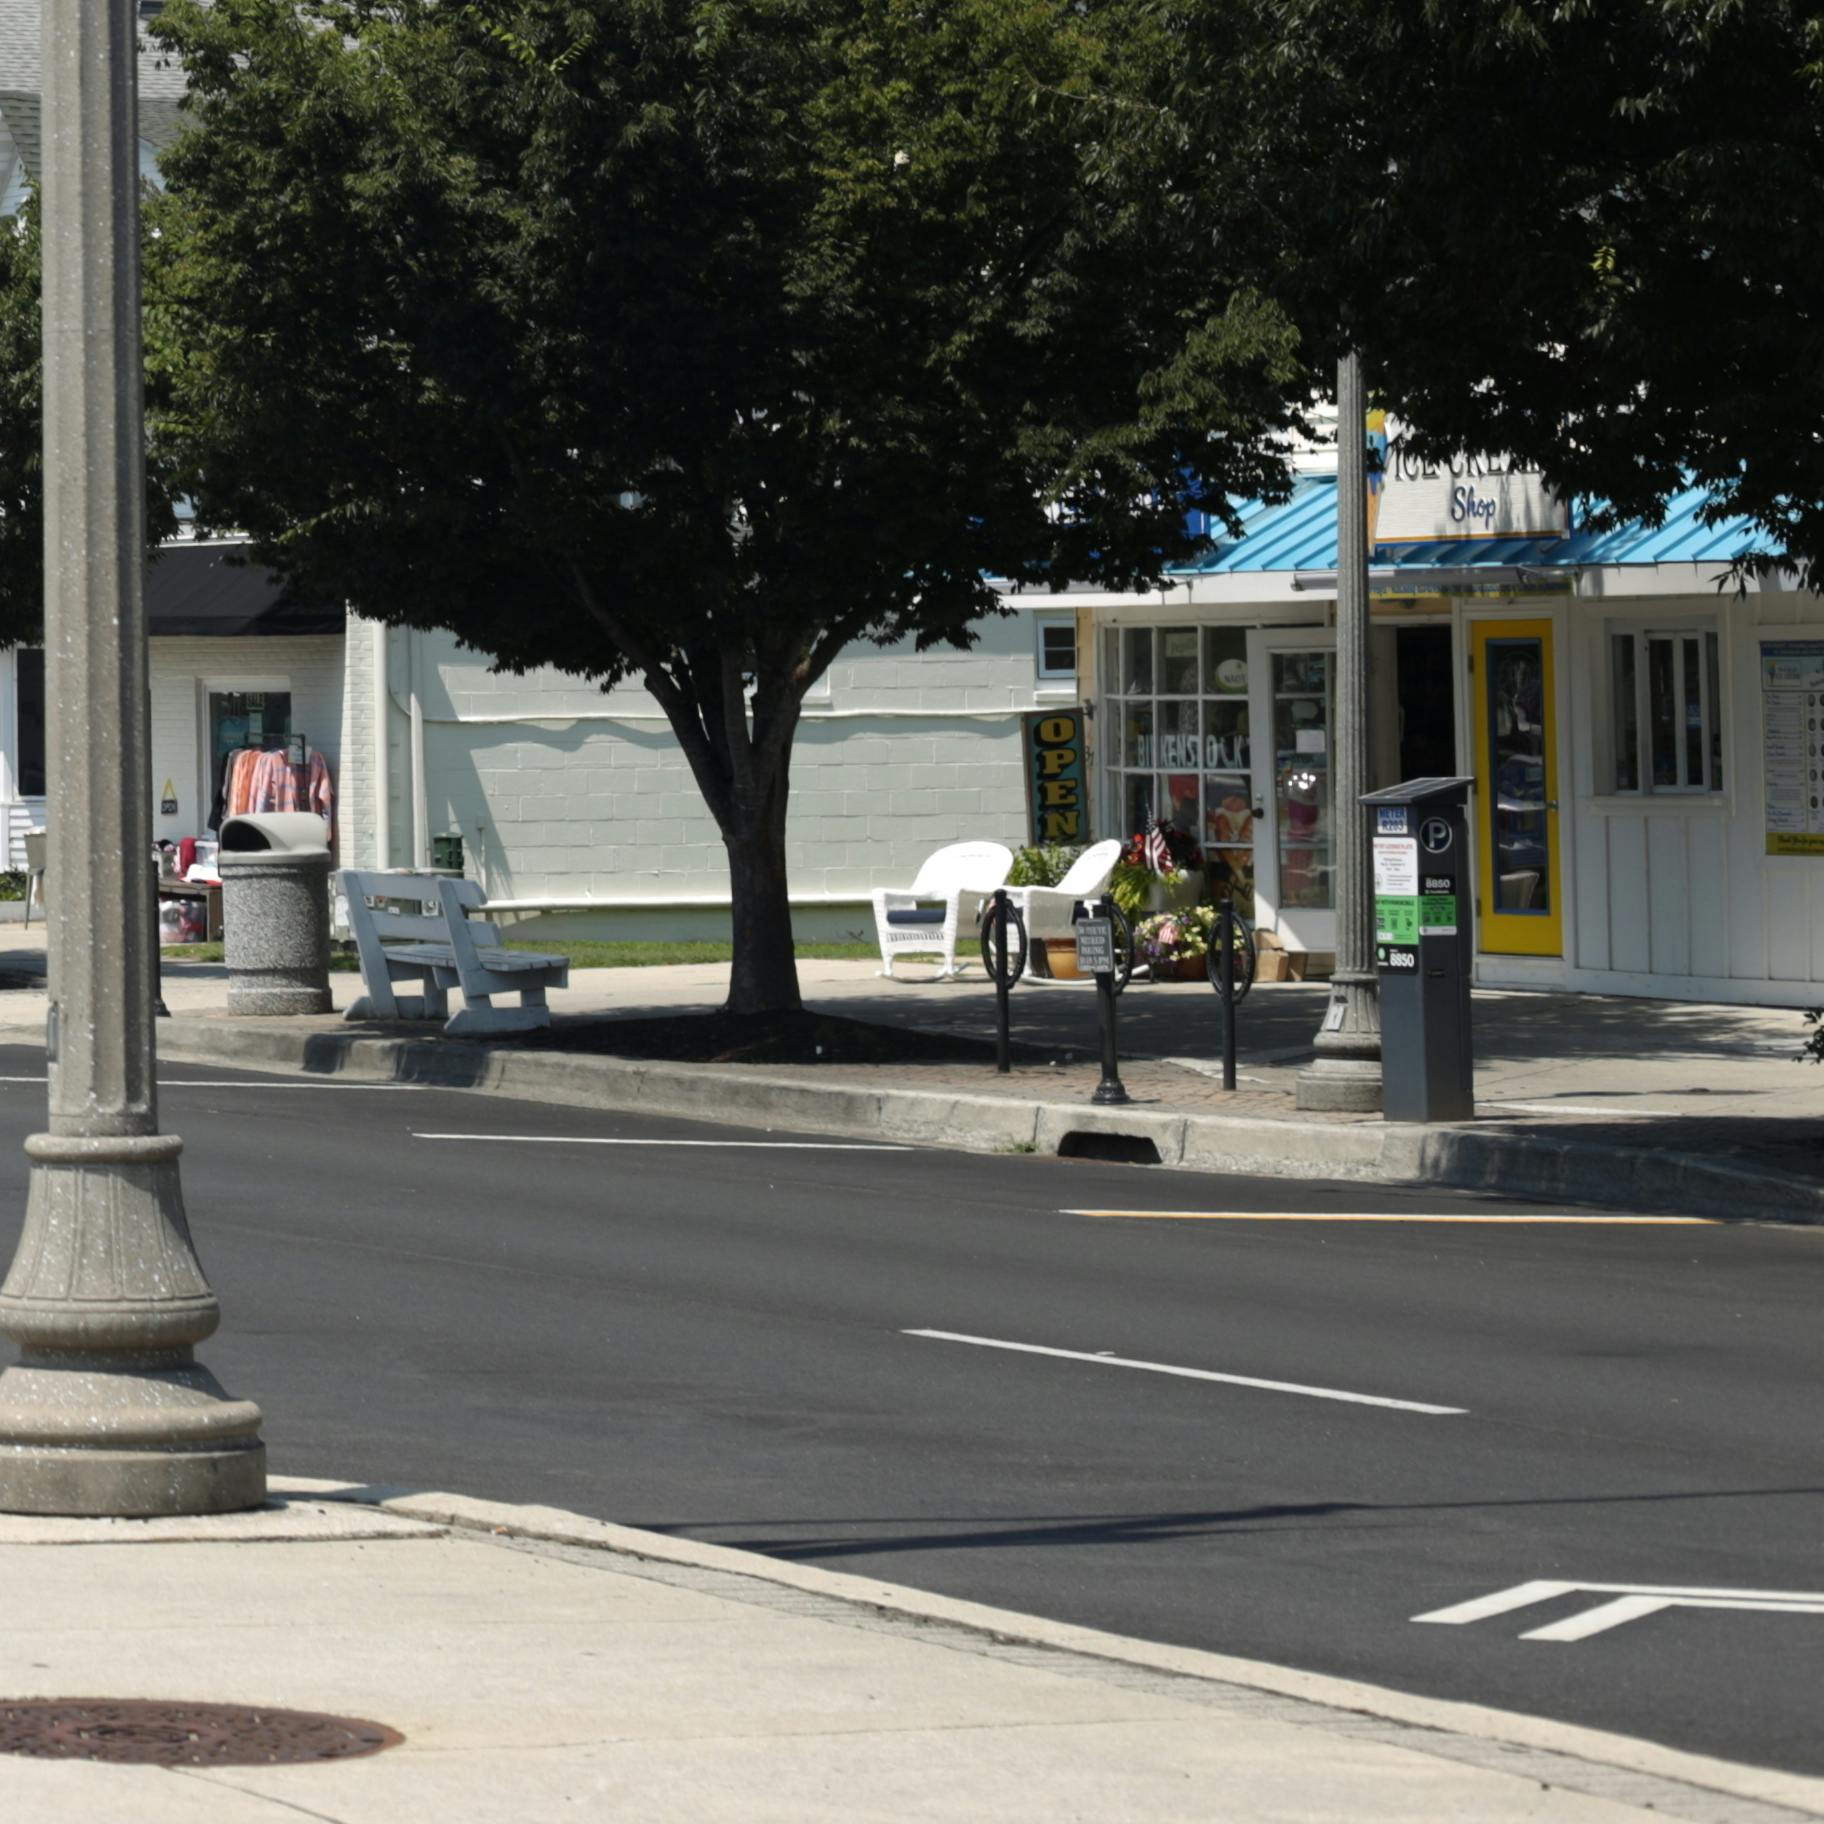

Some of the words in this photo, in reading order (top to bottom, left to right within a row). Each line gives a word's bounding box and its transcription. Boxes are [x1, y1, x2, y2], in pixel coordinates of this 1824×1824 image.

[1451, 486, 1497, 531] Shop
[1036, 716, 1080, 839] OPEN
[1389, 952, 1415, 968] 8850
